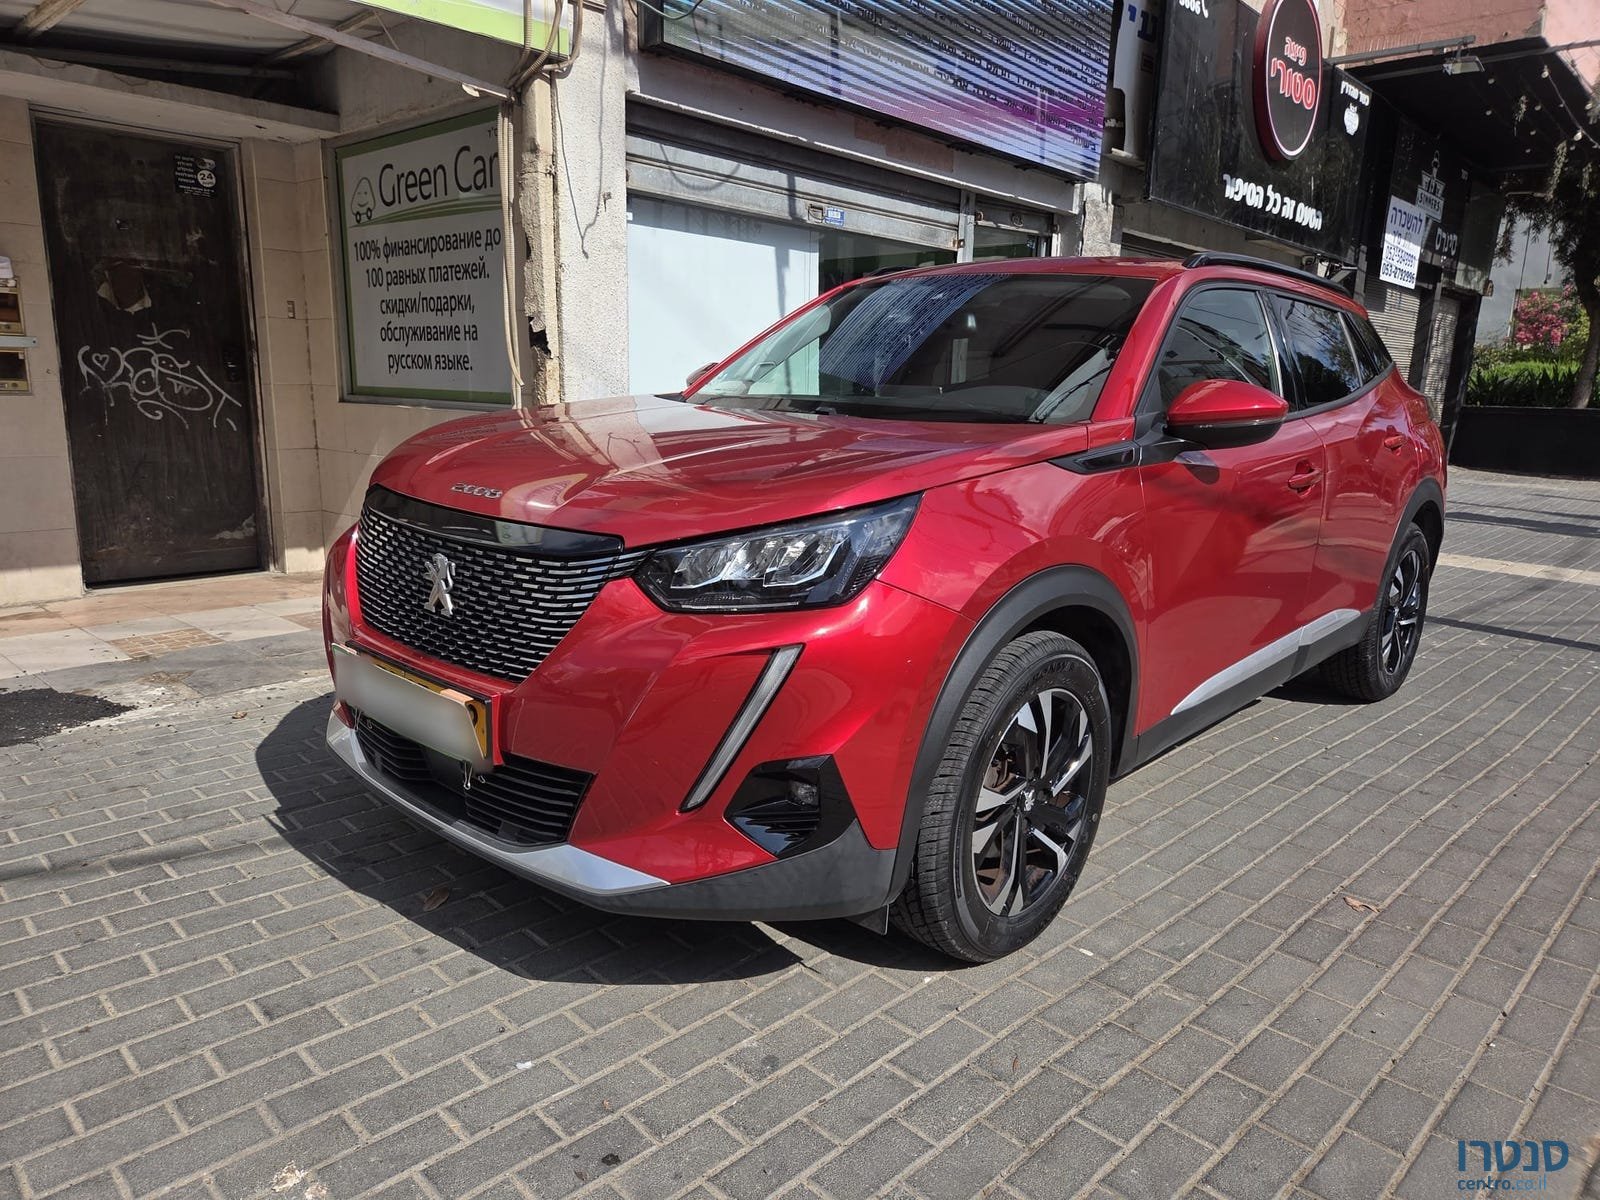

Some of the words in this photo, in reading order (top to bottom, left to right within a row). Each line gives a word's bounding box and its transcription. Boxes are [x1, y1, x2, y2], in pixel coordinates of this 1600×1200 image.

[1270, 58, 1316, 110] סטורי
[379, 164, 448, 206] Green
[454, 146, 498, 192] Car
[1223, 174, 1264, 209] הסיפור
[1265, 184, 1281, 214] כל
[1281, 197, 1296, 220] זה
[1295, 202, 1322, 231] הטעם
[1390, 207, 1422, 235] להשכרה
[354, 239, 381, 262] 100%
[383, 230, 481, 263] финансирование
[485, 227, 501, 251] до
[366, 268, 384, 288] 100
[386, 264, 426, 292] равных
[429, 256, 490, 283] платежей.
[380, 291, 475, 318] скидки/подарки,
[380, 320, 460, 347] обслуживание
[464, 324, 478, 341] на
[388, 354, 432, 374] русском
[435, 353, 473, 371] языке.
